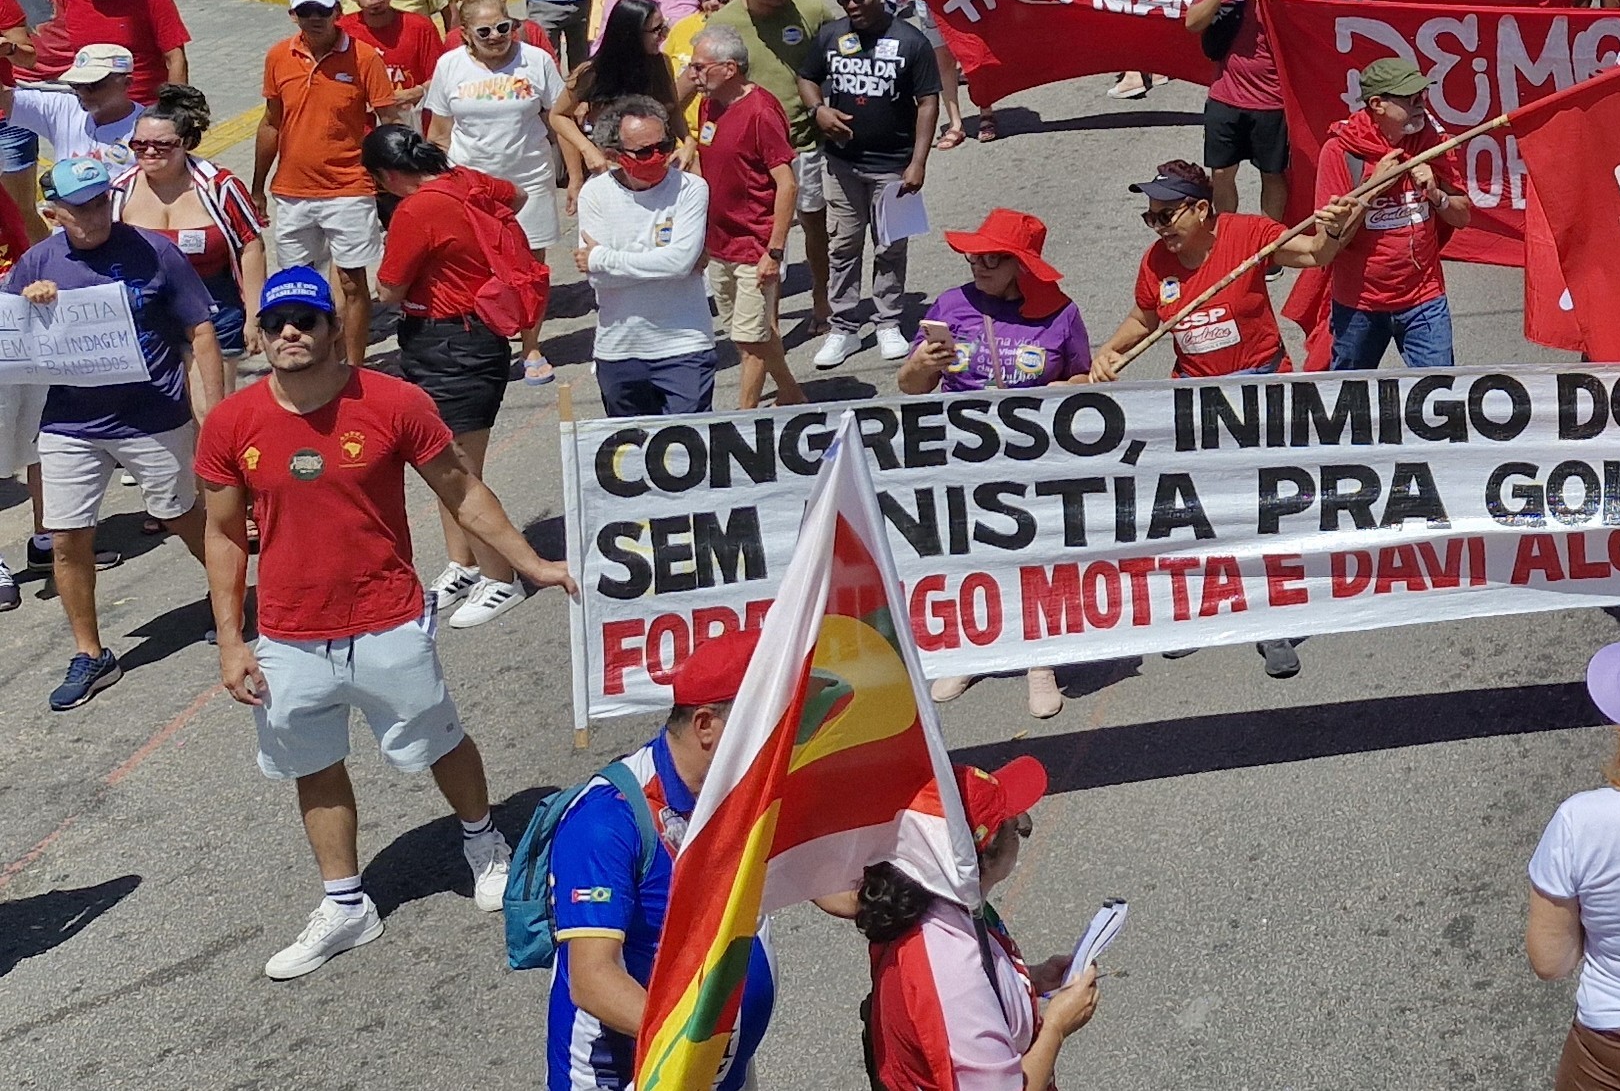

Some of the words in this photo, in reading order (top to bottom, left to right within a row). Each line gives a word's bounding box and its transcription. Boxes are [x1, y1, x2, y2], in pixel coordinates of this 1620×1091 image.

[831, 57, 872, 76] FORA
[874, 60, 897, 79] DA
[832, 75, 895, 97] ORDEM
[1175, 307, 1227, 330] CSP
[594, 391, 1145, 498] CONGRESSO,
[1174, 374, 1532, 453] INIMIGO
[596, 507, 769, 600] SEM
[803, 472, 1216, 557] NISTIA
[1258, 462, 1450, 535] PRA
[1021, 556, 1247, 641] MOTTA
[1265, 553, 1308, 607] E
[1330, 537, 1488, 600] DAVI
